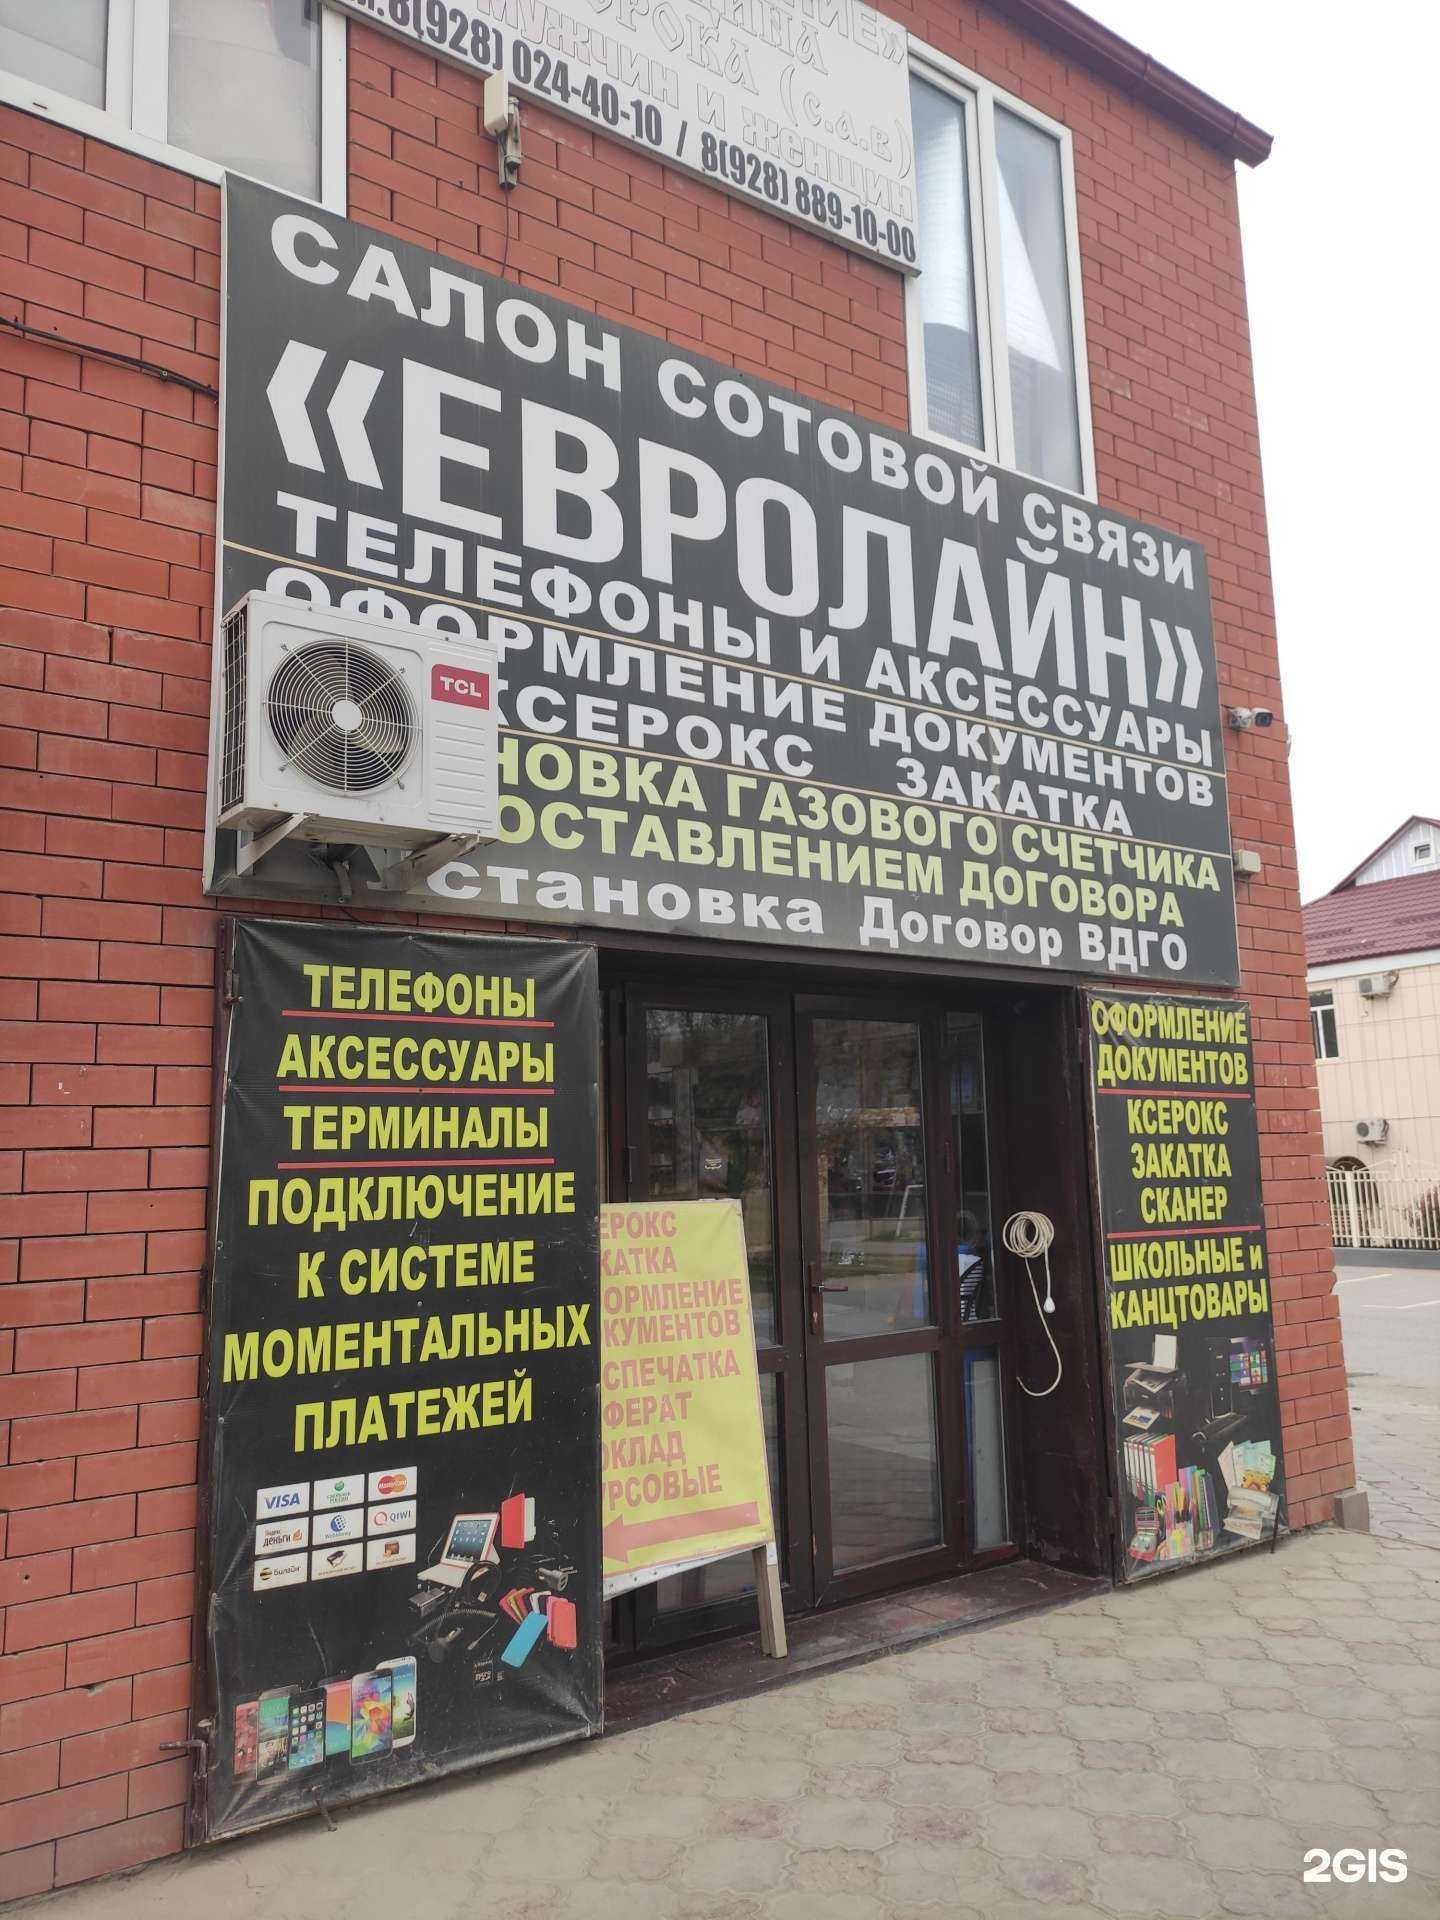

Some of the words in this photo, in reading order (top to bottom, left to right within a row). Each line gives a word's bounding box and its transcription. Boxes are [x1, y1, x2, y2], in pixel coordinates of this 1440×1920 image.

[512, 39, 663, 146] 024-40-10
[676, 120, 688, 158] /
[701, 131, 789, 206] 8(928)
[795, 175, 917, 264] 889-10-00
[271, 213, 622, 393] САЛОН
[657, 358, 1001, 524] СОТОВОЙ
[1022, 492, 1195, 590] СВЯЗИ
[266, 339, 1203, 710] «ЕВРОЛАЙН»
[276, 490, 771, 666] ТЕЛЕФОНЫ
[799, 627, 841, 681] И
[865, 647, 1214, 767] АКСЕССУАРЫ
[440, 676, 482, 698] TCL
[869, 700, 1215, 808] ДОКУМЕНТОВ
[896, 757, 1134, 837] ЗАКАТКА
[726, 773, 998, 856] ГАЗОВОГО
[1011, 824, 1221, 892] СЧЕТЧИКА
[497, 794, 944, 896] ОСТАВЛЕНИЕМ
[959, 860, 1185, 928] ДОГОВОРА
[859, 896, 1064, 965] Договор
[1078, 921, 1189, 973] ВДГО
[303, 963, 536, 1018] ТЕЛЕФОНЫ
[1091, 1000, 1249, 1045] ОФОРМЛЕНИЕ
[275, 1033, 555, 1083] АКСЕССУАРЫ
[1097, 1043, 1249, 1087] ДОКУМЕНТОВ
[283, 1105, 548, 1151] ТЕРМИНАЛЫ
[1127, 1098, 1229, 1136] КСЕРОКС
[1130, 1142, 1232, 1180] ЗАКАТКА
[247, 1171, 576, 1233] ПОДКЛЮЧЕНИЕ
[1140, 1185, 1228, 1224] СКАНЕР
[297, 1251, 327, 1299] К
[339, 1240, 535, 1296] СИСТЕМЕ
[1110, 1236, 1245, 1282] ШКОЛЬНЫЕ
[604, 1278, 744, 1315] ОРМЛЕНИЕ
[1110, 1278, 1269, 1330] КАНЦТОВАРЫ
[222, 1303, 592, 1384] МОМЕНТАЛЬНЫХ
[603, 1308, 741, 1347] КУМЕНТОВ
[603, 1349, 742, 1391] СПЕЧАТКА
[294, 1367, 533, 1453] ПЛАТЕЖЕЙ
[602, 1391, 694, 1430] ФЕРАТ
[265, 1492, 301, 1510] VISA
[602, 1463, 723, 1511] РСОВЫЕ
[389, 1510, 411, 1521] QIWI
